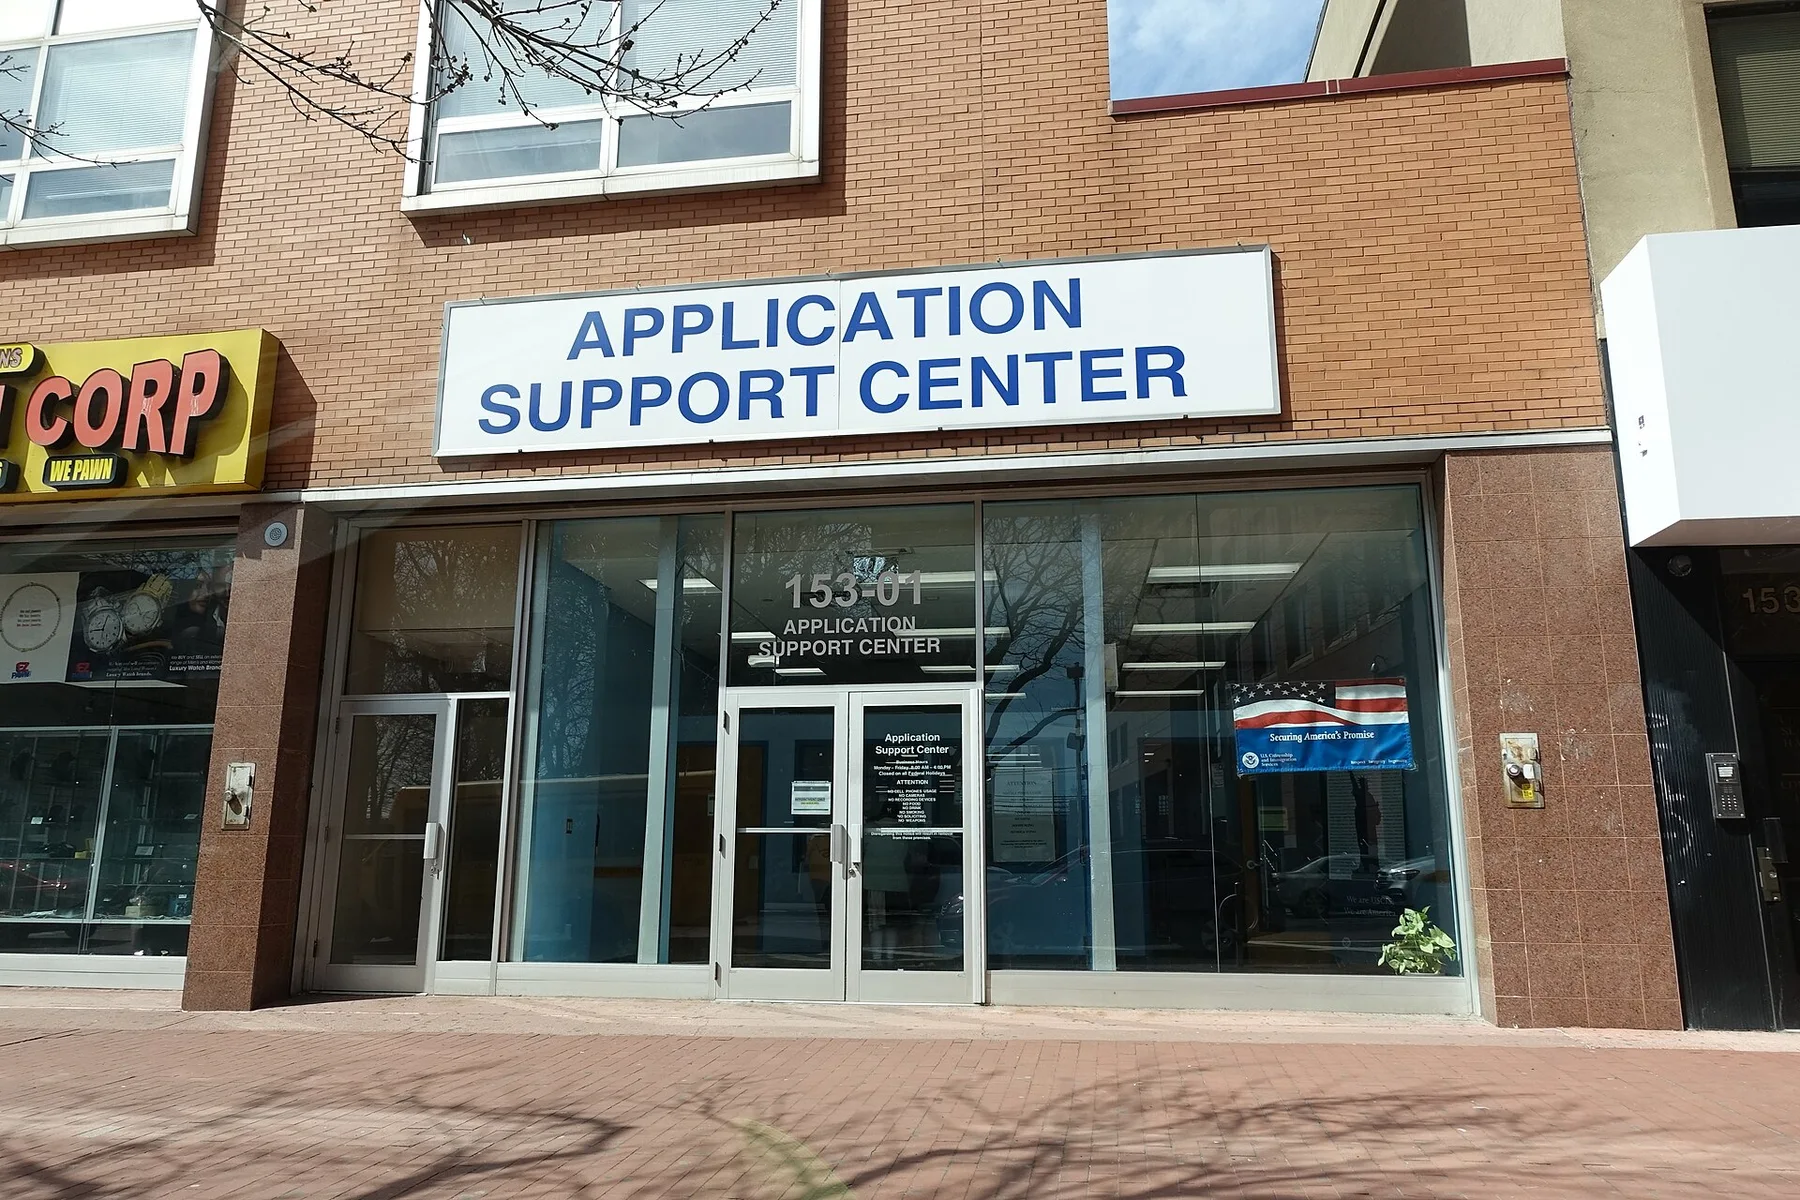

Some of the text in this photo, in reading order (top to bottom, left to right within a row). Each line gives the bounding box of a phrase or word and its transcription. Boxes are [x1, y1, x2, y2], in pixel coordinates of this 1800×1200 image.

[567, 278, 1081, 360] APPLICATION
[478, 345, 1188, 434] SUPPORT CENTER
[25, 348, 221, 455] CORP
[50, 457, 113, 482] WE PAWN
[785, 569, 921, 609] 153-01
[783, 616, 916, 635] APPLICATION
[758, 637, 941, 658] SUPPORT CENTER
[884, 733, 940, 744] Application
[1270, 730, 1375, 743] Securing America's Promise
[876, 746, 950, 756] Support Center
